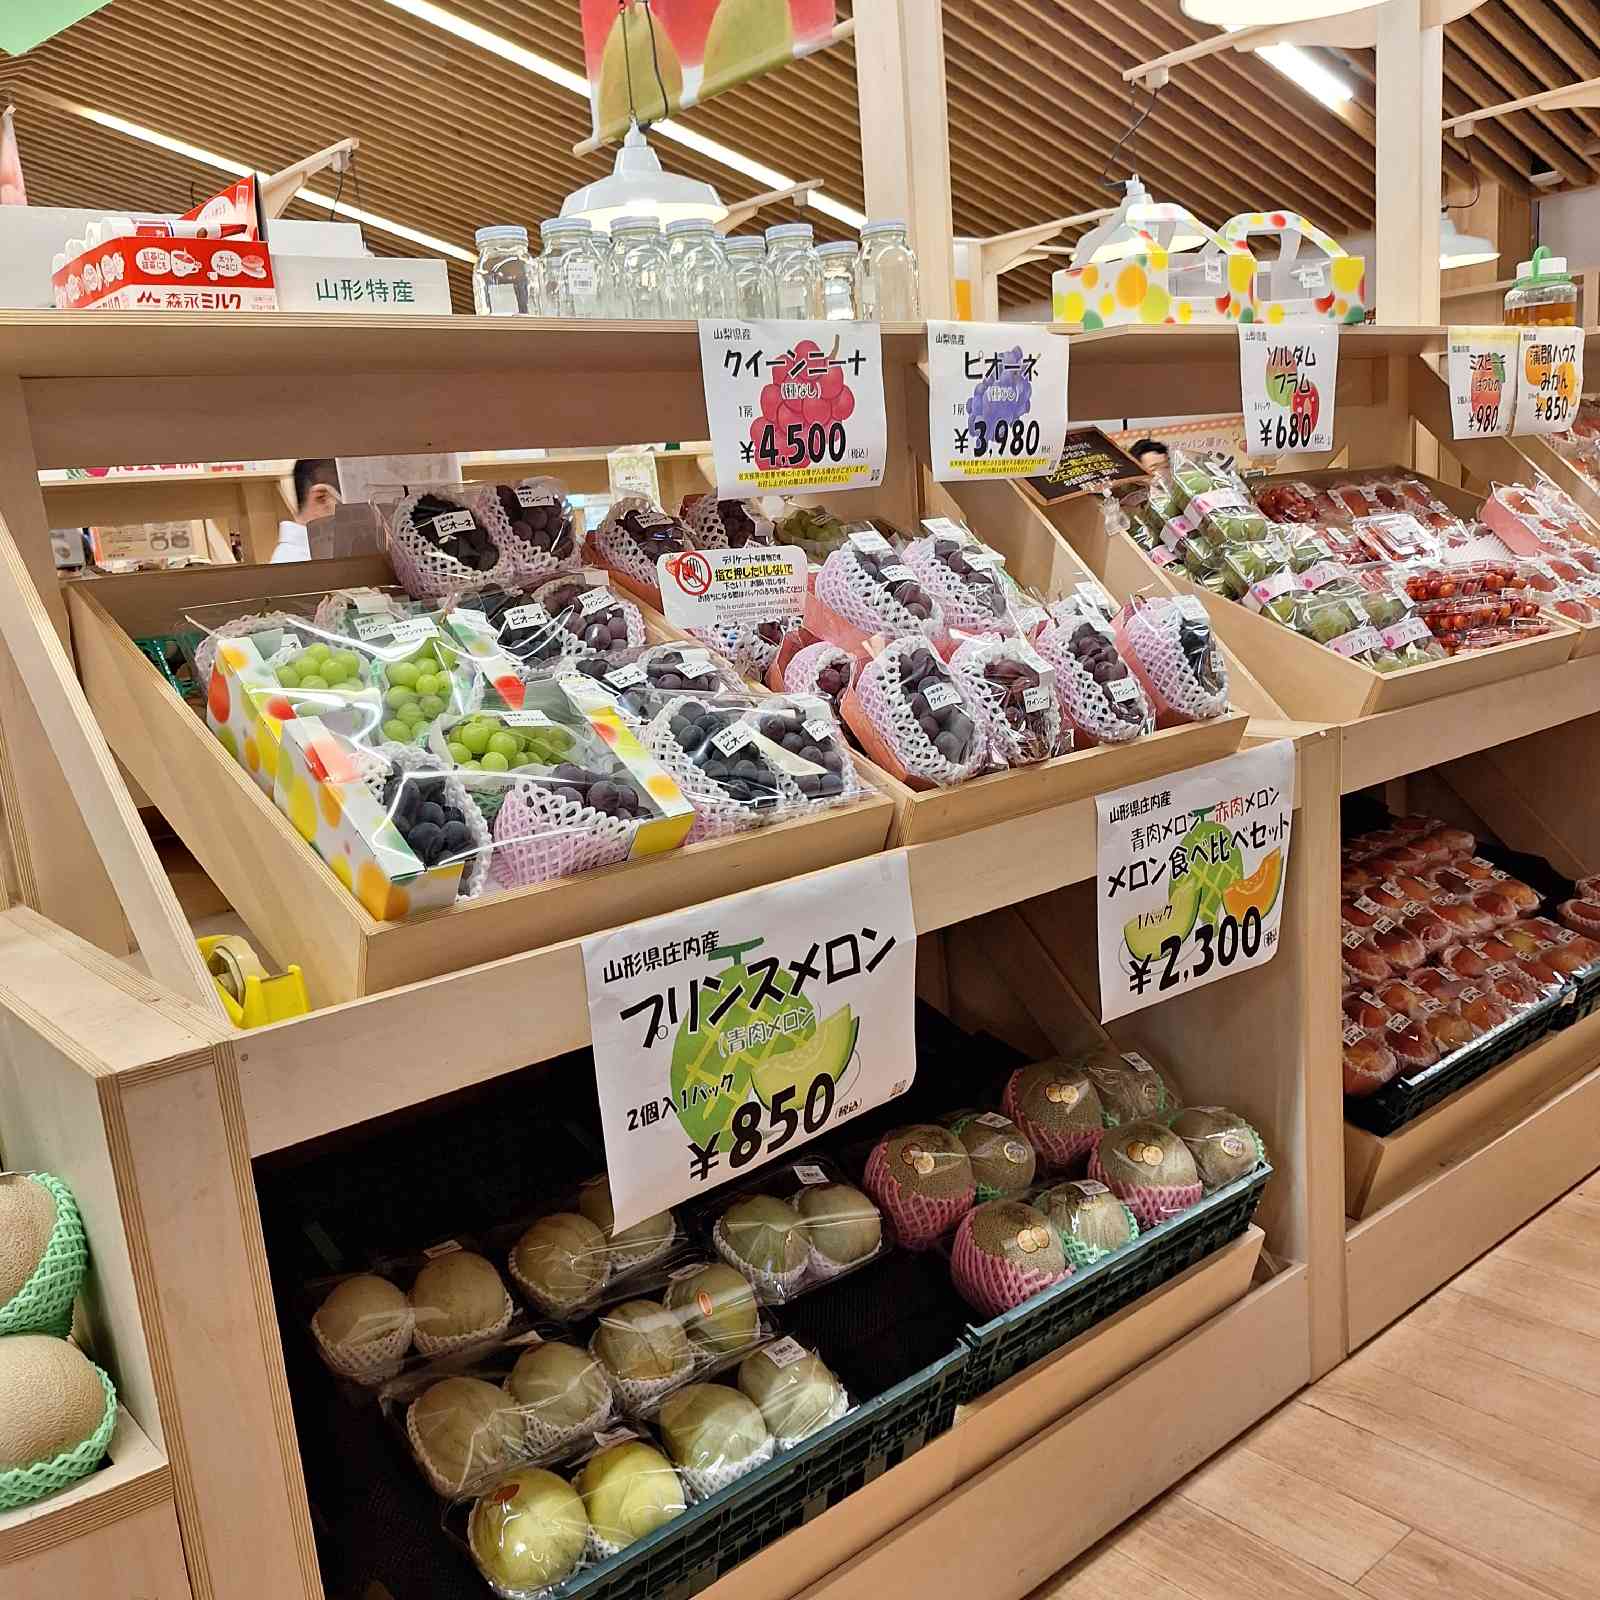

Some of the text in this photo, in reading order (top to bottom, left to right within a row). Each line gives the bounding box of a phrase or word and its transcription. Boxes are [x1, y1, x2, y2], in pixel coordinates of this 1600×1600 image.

[165, 293, 242, 309] 森永ミルク
[315, 278, 415, 303] 山形特産
[713, 327, 751, 341] 山梨県産
[724, 348, 867, 377] クイーンニーナ
[964, 350, 1040, 381] ピオーネ
[1267, 345, 1316, 367] ソルダム
[1529, 344, 1576, 366] 蒲郡ハウス
[1540, 371, 1568, 391] みかん
[1468, 405, 1499, 432] ¥980
[1535, 396, 1569, 421] ¥850
[739, 422, 847, 466] ¥4,500
[954, 420, 1040, 458] ¥3,980
[1259, 413, 1311, 449] ¥680
[715, 564, 793, 581] 指で押したりしないで
[1109, 790, 1172, 825] 山形県庄内産
[1130, 786, 1280, 852] 青肉メロン 赤肉メロン
[1107, 812, 1289, 898] メロン食べ比べセット
[603, 930, 721, 984] 山形県庄内産
[1129, 906, 1262, 995] ¥2,300
[619, 927, 897, 1049] プリンスメロン
[718, 1001, 822, 1058] (青肉メロン)
[689, 1072, 863, 1180] ¥850 (税込)
